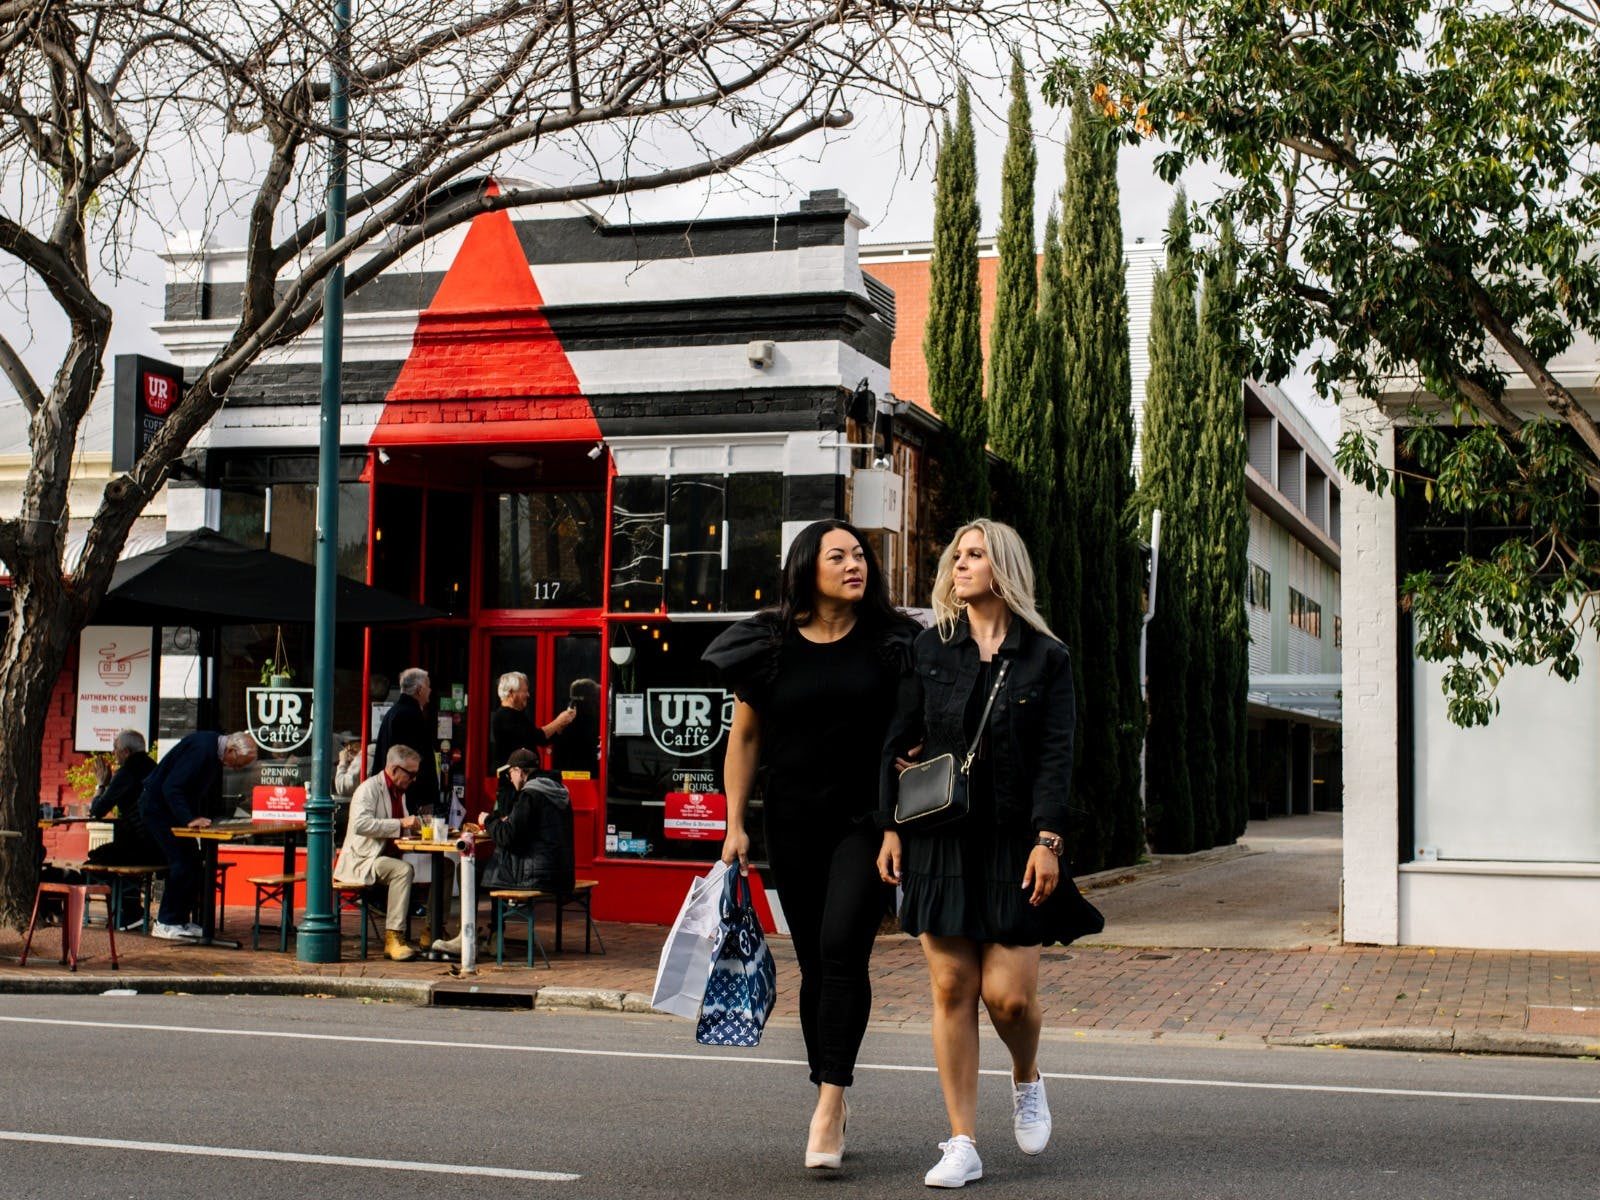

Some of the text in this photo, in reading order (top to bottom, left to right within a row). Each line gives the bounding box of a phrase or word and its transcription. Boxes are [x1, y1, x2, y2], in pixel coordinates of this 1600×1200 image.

[148, 376, 168, 400] UR
[533, 582, 560, 600] 117
[256, 693, 302, 724] UR
[658, 694, 711, 727] UR
[257, 724, 300, 742] Caffé
[661, 727, 710, 746] Caffé
[260, 768, 297, 777] OPENING
[672, 773, 714, 782] OPENING
